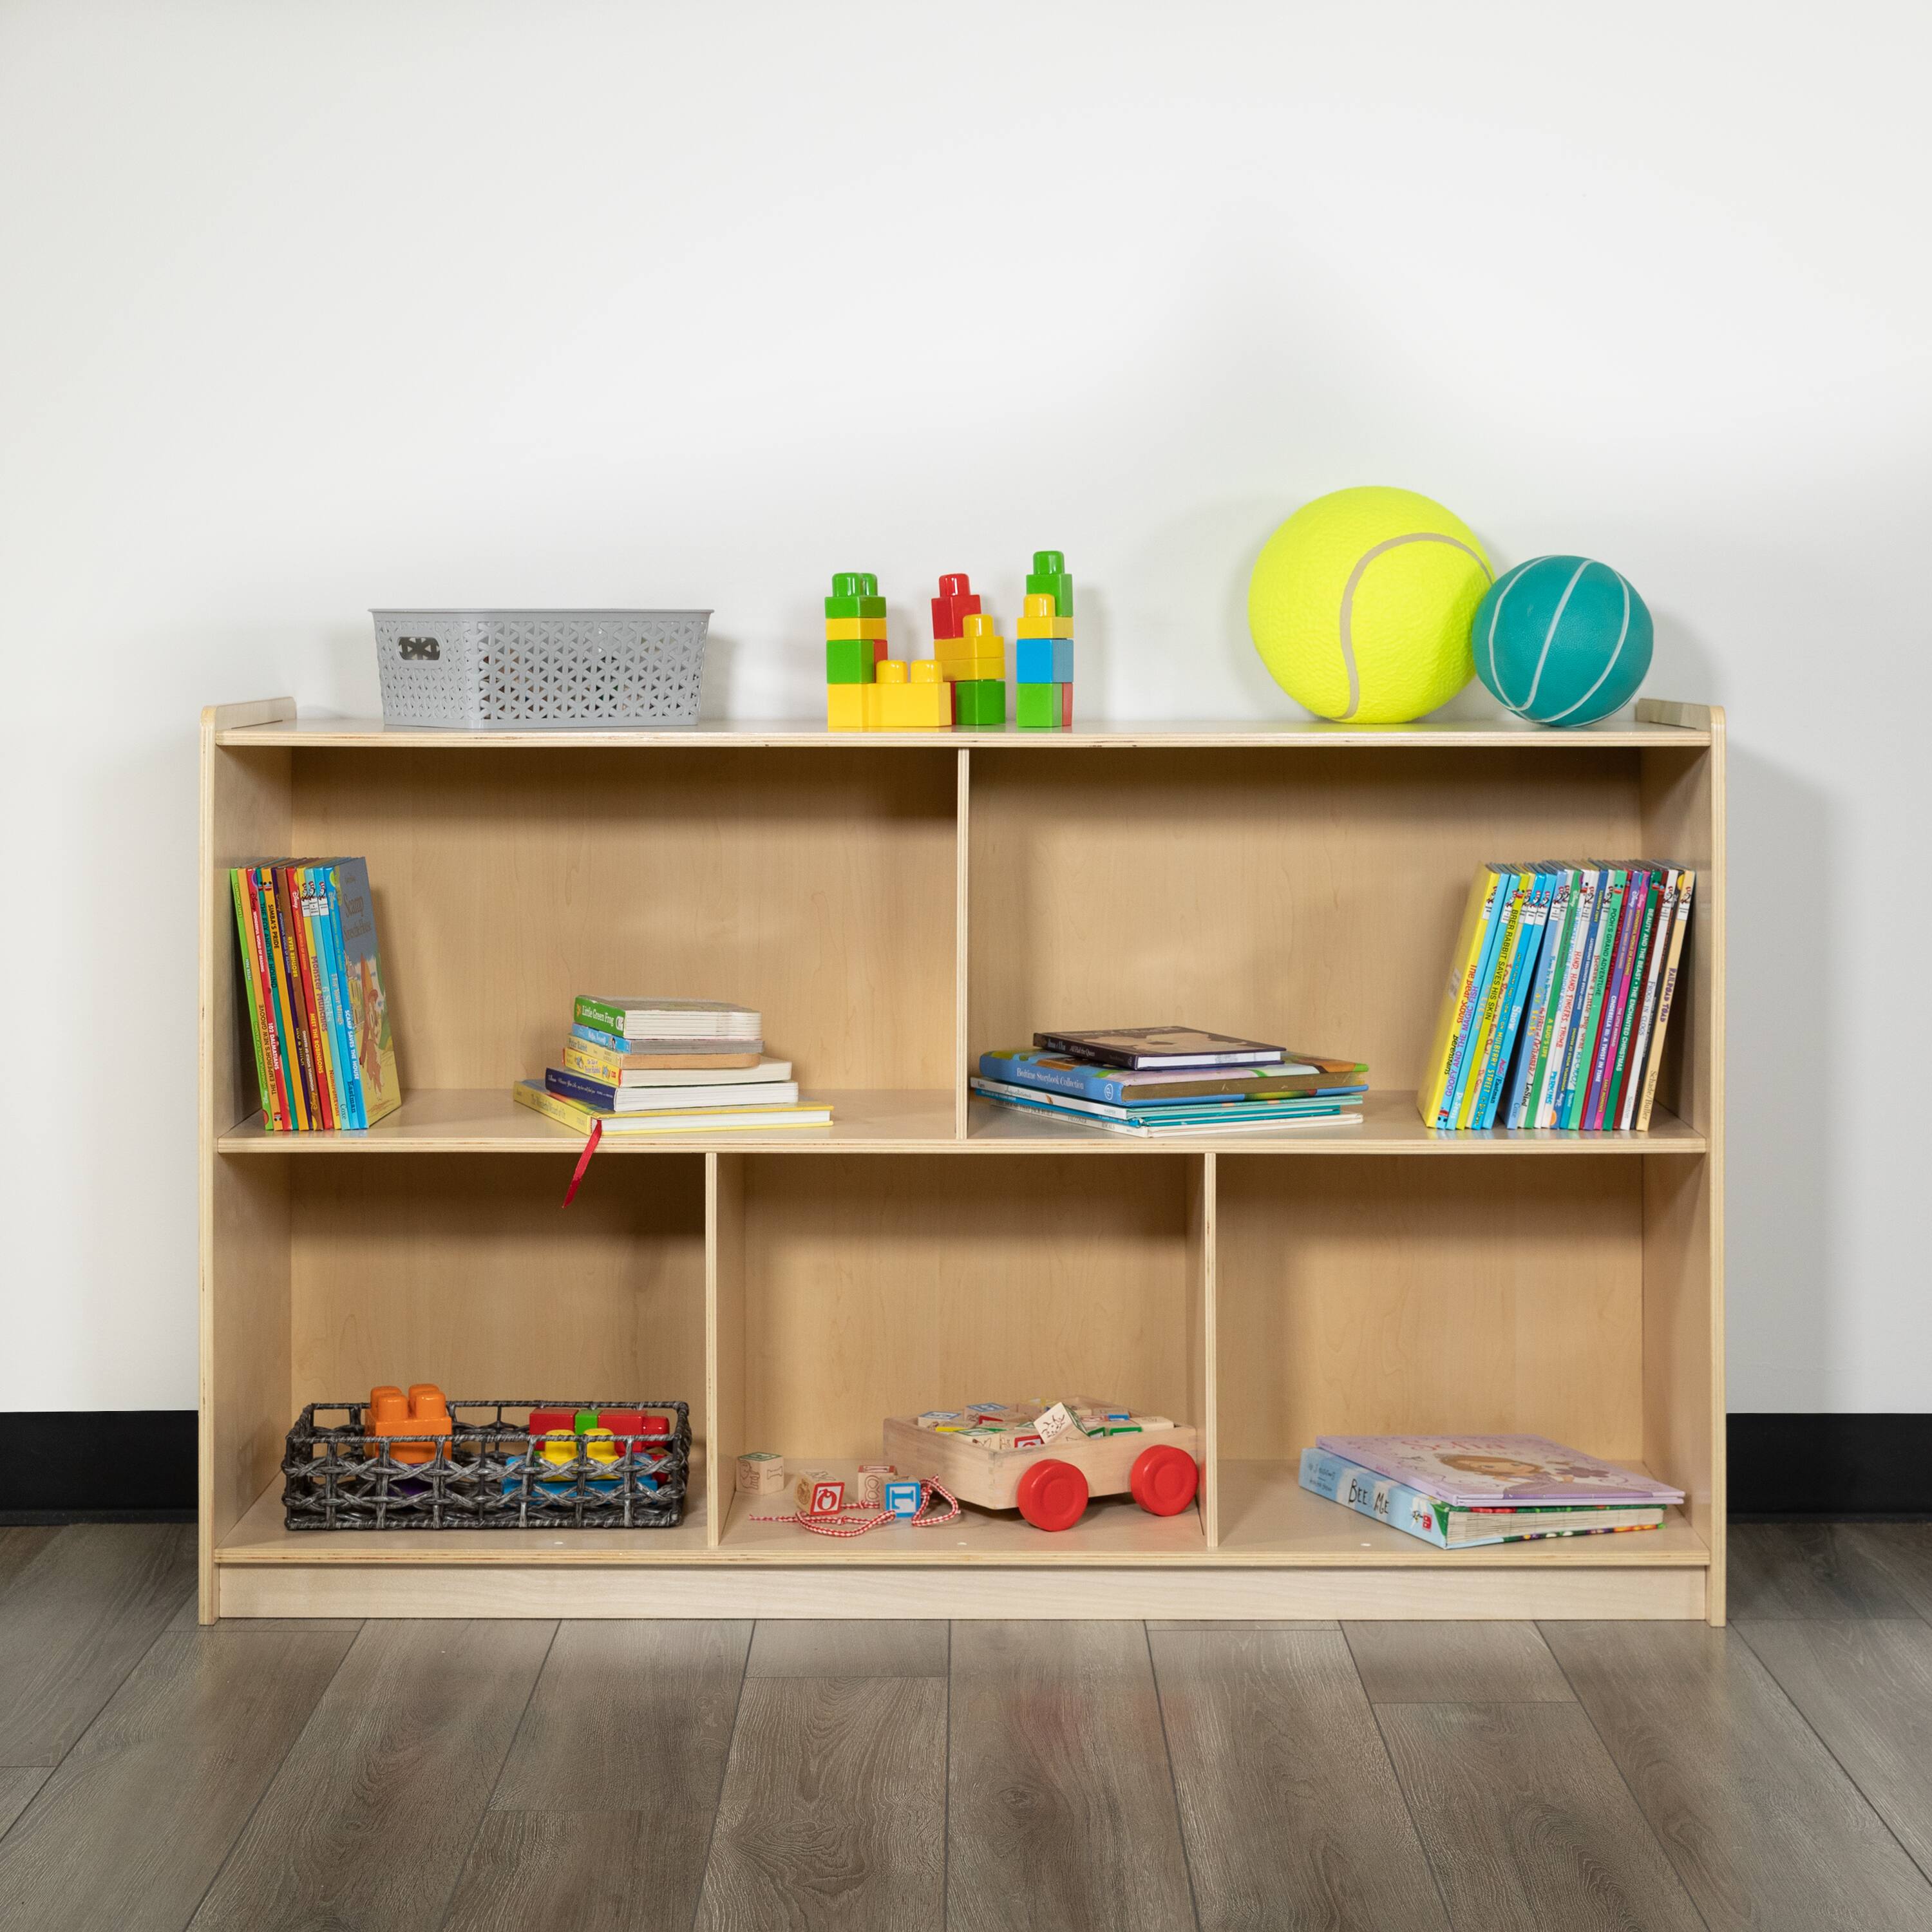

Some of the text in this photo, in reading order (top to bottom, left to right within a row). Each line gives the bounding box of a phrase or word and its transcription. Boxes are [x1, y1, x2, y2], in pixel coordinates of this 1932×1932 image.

[291, 890, 301, 909] Disney
[1629, 890, 1638, 907] Disney
[1508, 909, 1518, 929] BRER
[1607, 908, 1617, 932] POOH'S
[1644, 909, 1654, 931] BEAUTY
[1501, 931, 1512, 958] RABBIT
[1603, 934, 1612, 956] GRAND
[269, 963, 278, 988] HOUND
[1494, 961, 1504, 985] SAVES
[1596, 958, 1607, 996] ADVENTURE
[1635, 961, 1643, 980] BEAST
[311, 956, 328, 1032] Monster Munchies
[1645, 981, 1655, 1003] FROGS
[1664, 968, 1676, 1001] RAILROAD
[324, 995, 334, 1021] Sticks
[1485, 1002, 1494, 1019] SKIN
[1558, 951, 1581, 1047] HAND, HAND, FINGERS, THUMB
[1605, 995, 1616, 1027] CINDERELLA
[259, 1004, 267, 1029] GROOVE
[582, 1005, 592, 1018] Little
[592, 1009, 604, 1021] Green
[605, 1012, 614, 1027] Frog
[1508, 1005, 1521, 1030] Snow
[1624, 999, 1635, 1035] ENCHANTED
[1660, 1004, 1669, 1022] TOAD
[1639, 1016, 1647, 1036] CLOGS
[270, 1034, 279, 1070] DALMATIANS
[1446, 1068, 1457, 1096] GOOFY
[1453, 1051, 1462, 1066] AND
[1462, 1005, 1473, 1030] MAGIC
[1469, 986, 1478, 1003] FISH
[1490, 1032, 1504, 1066] MULBERRY
[1616, 1036, 1628, 1071] CHRISTMAS
[265, 1046, 274, 1081] EMPEROR'S
[314, 1040, 324, 1074] ROBINSONS
[1017, 1068, 1084, 1090] Bedtime Storybook Collection
[1483, 1069, 1495, 1092] STREET
[1490, 1079, 1501, 1103] Eastman
[1546, 1071, 1557, 1104] PERKINS
[348, 1081, 357, 1113] Eastman
[1642, 1070, 1658, 1120] Schade/Buller
[1511, 1103, 1520, 1117] Coxe
[1349, 1479, 1368, 1505] BEE
[1374, 1492, 1388, 1514] ME
